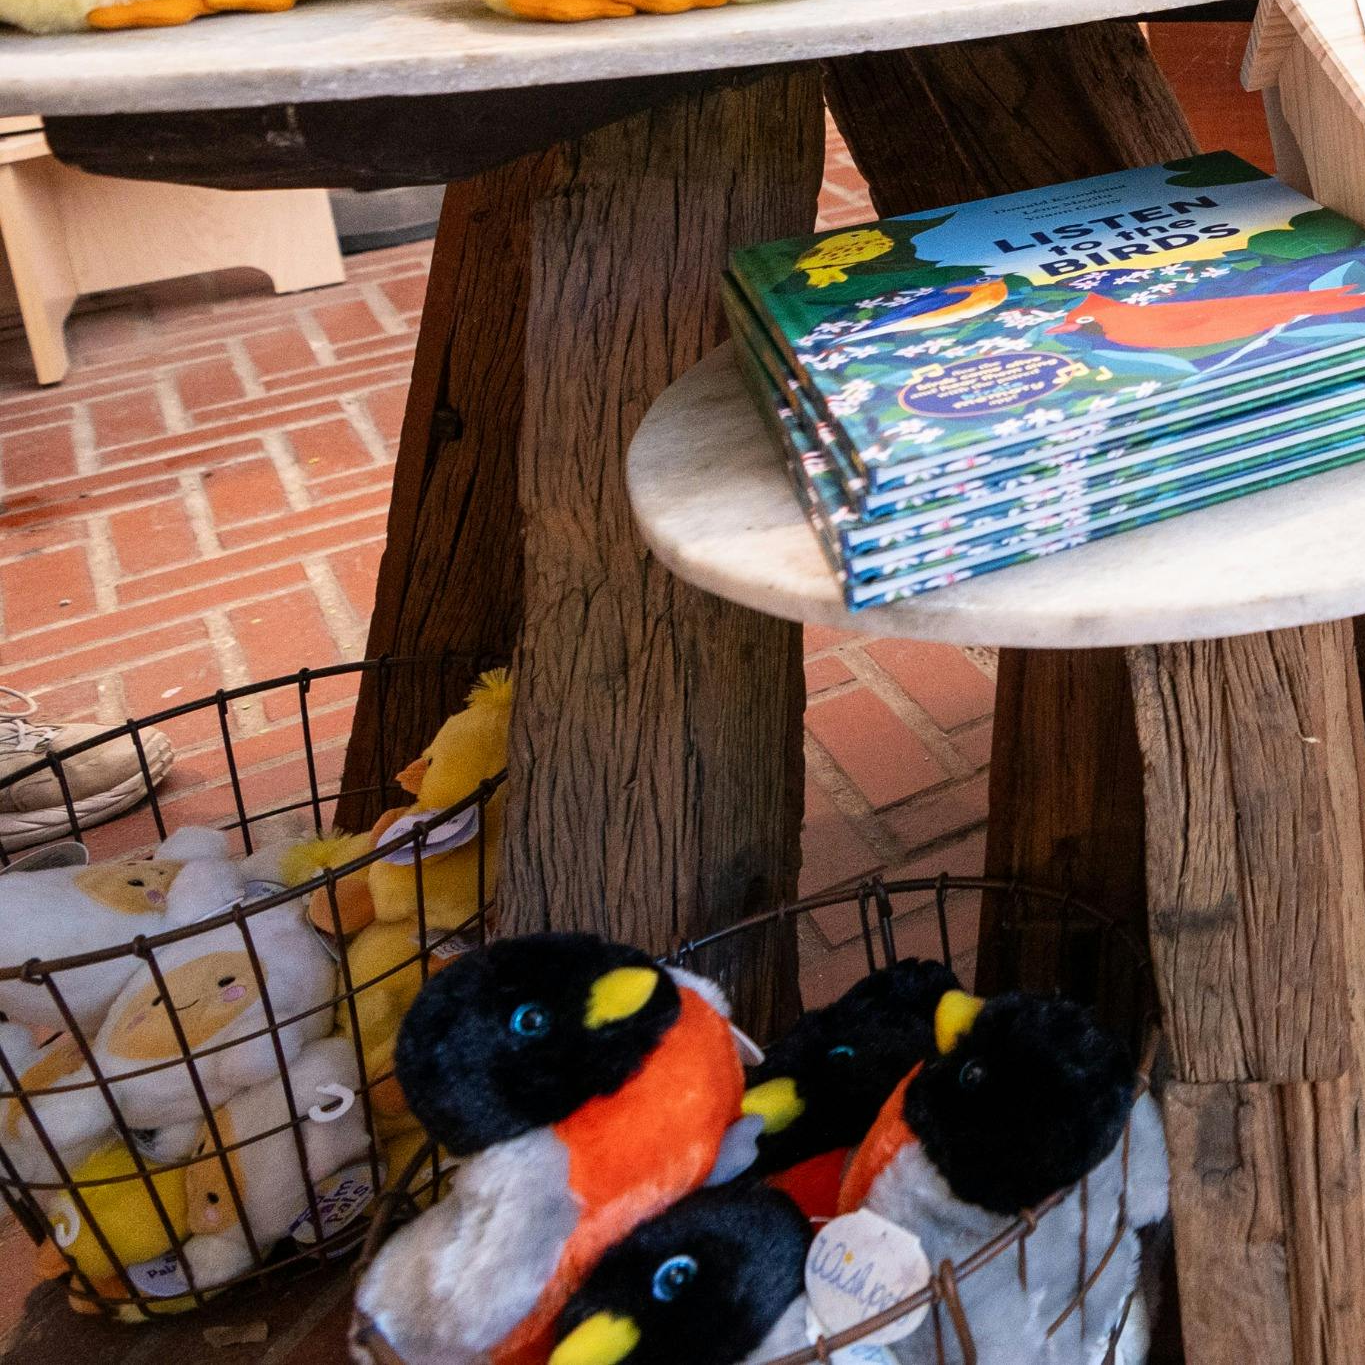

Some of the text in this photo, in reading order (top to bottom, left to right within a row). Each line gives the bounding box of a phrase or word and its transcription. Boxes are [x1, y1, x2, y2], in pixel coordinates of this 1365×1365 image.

[993, 195, 1219, 254] LISTEN
[1039, 223, 1241, 277] BIRDS
[1048, 219, 1197, 257] to the
